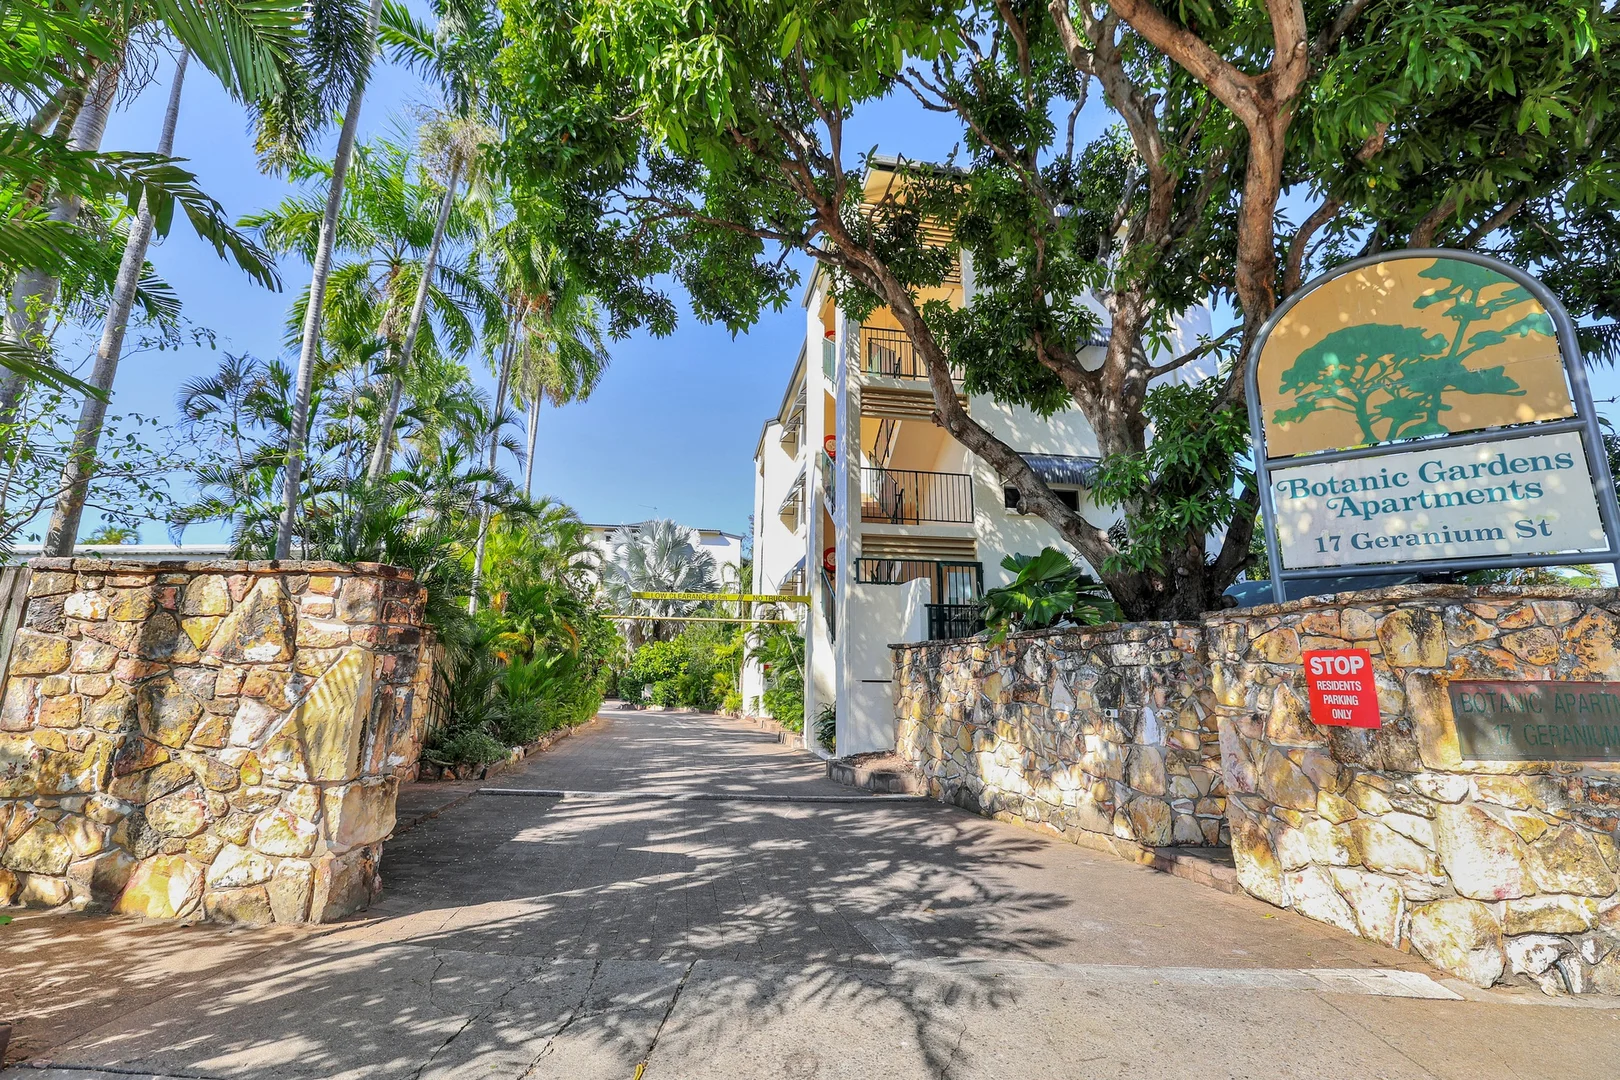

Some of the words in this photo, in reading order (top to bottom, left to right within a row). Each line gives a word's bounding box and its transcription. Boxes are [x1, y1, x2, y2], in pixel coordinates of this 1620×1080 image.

[1276, 467, 1409, 499] Botanic
[1418, 452, 1574, 484] Gardens
[1327, 480, 1543, 520] Apartments
[1315, 535, 1341, 552] 17
[1351, 525, 1504, 550] Geranium
[1515, 519, 1552, 538] St
[1310, 656, 1364, 675] STOP
[1317, 681, 1362, 691] RESIDENTS
[1323, 695, 1359, 706] PARKING
[1460, 692, 1543, 714] BOTANIC
[1332, 709, 1352, 720] ONLY
[1495, 724, 1511, 745] 17
[1524, 724, 1620, 746] GERANIUM
